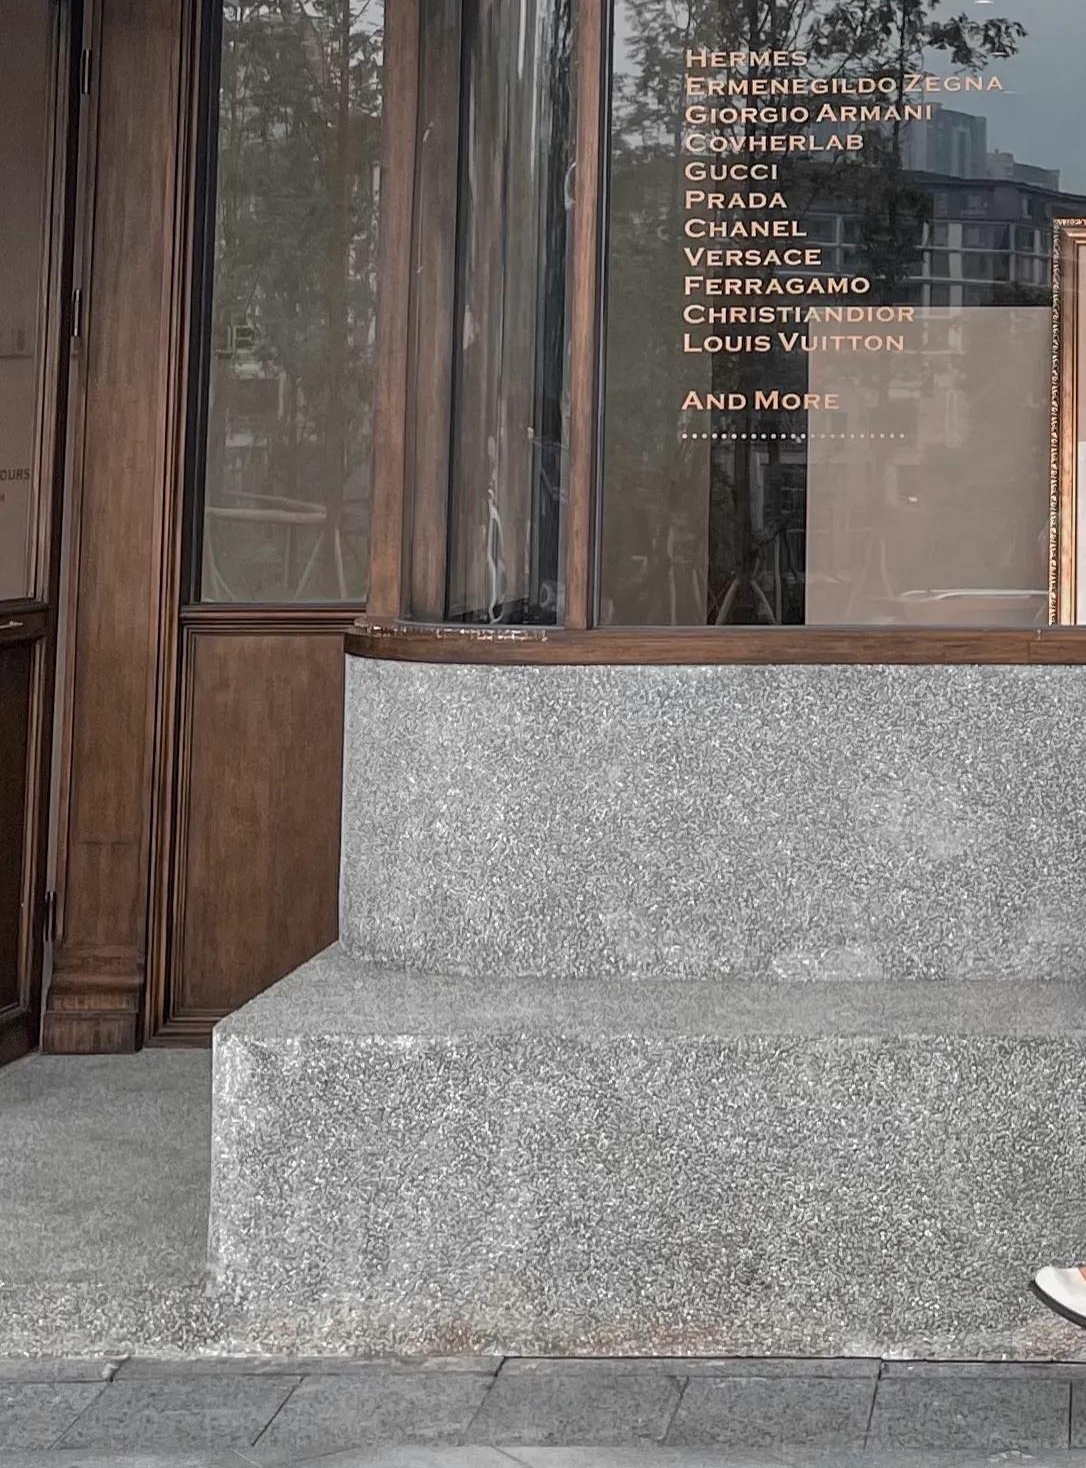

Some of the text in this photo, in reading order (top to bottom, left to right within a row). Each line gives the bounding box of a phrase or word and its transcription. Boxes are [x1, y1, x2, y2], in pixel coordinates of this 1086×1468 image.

[686, 48, 808, 68] HERMES
[686, 74, 1004, 96] ERMENEGILDO ZEGNA
[685, 103, 933, 124] GIORGIO ARMANI
[685, 133, 864, 153] COVHERLAB
[684, 161, 778, 181] GUCCI
[685, 190, 787, 210] PRADA
[684, 219, 807, 238] CHANEL
[684, 247, 822, 267] VERSACE
[684, 276, 870, 295] FERRAGAMO
[683, 304, 915, 324] CHRISTIANDIOR
[683, 333, 905, 353] LOUIS VUITTON
[681, 390, 840, 411] AND MORE
